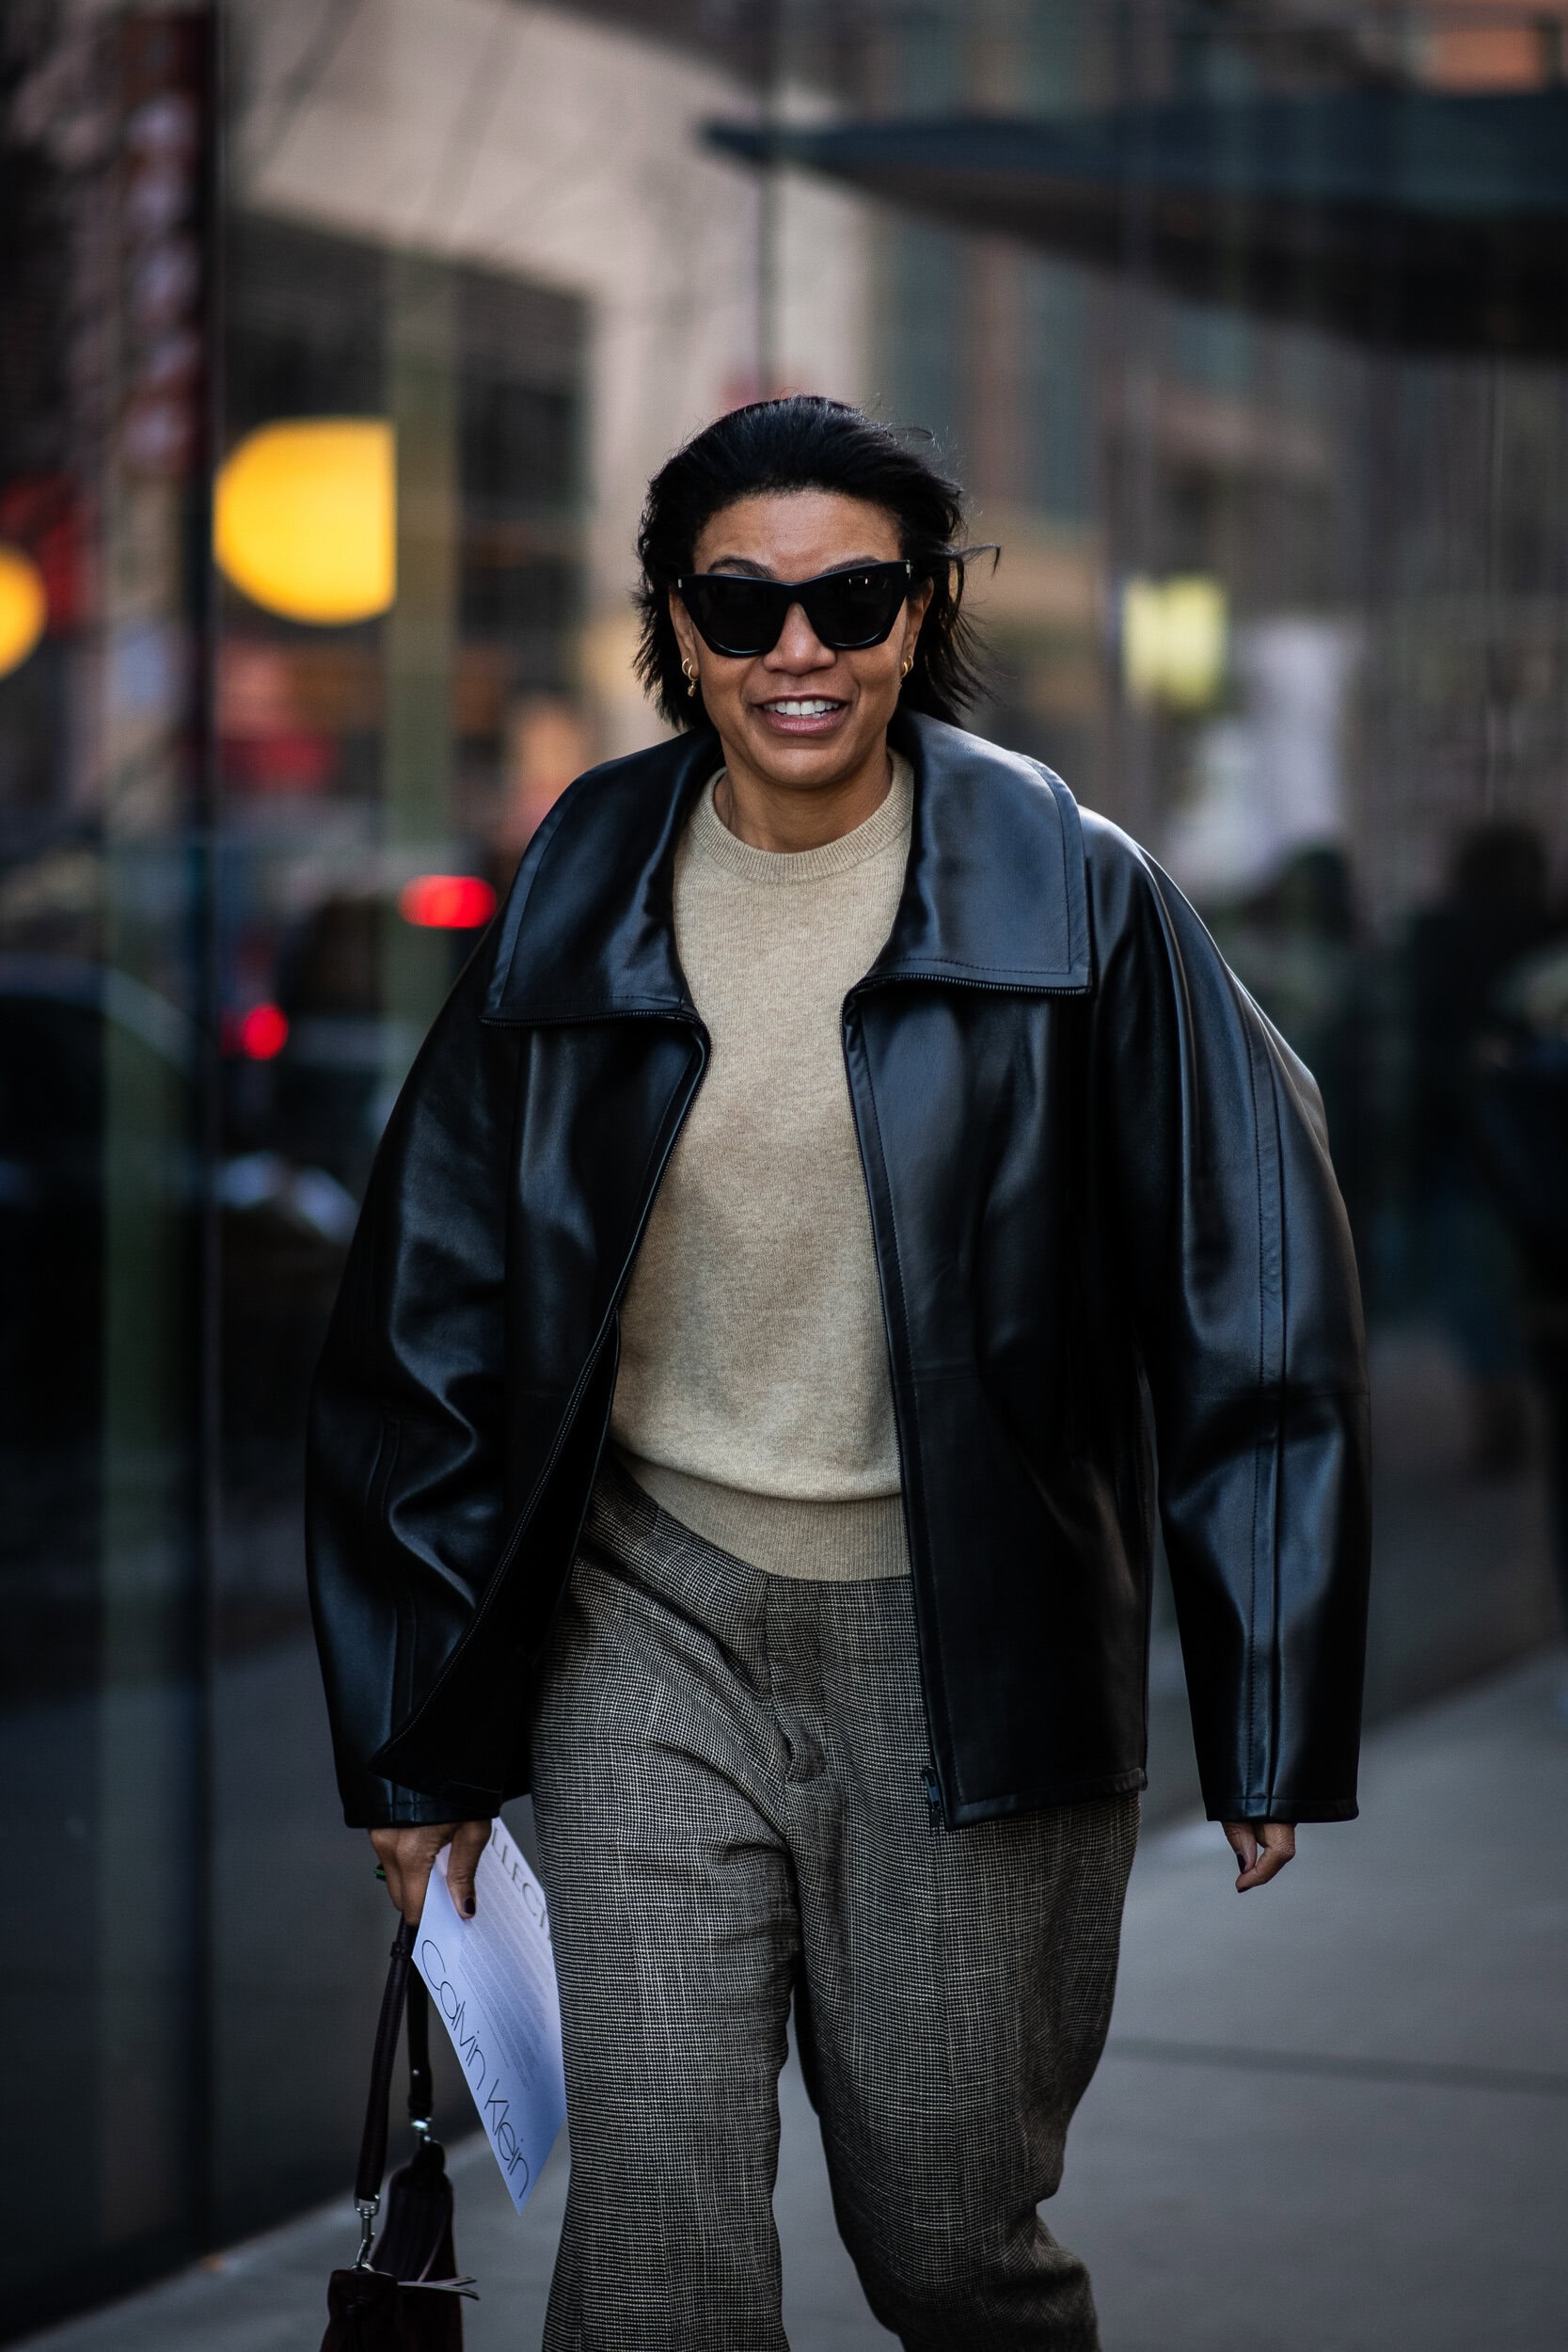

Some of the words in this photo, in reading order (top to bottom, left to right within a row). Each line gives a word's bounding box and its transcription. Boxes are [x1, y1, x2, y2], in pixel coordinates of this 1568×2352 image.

[491, 1823, 549, 1940] LLECT
[421, 1939, 486, 2090] Calvin
[483, 2077, 530, 2200] Klein
